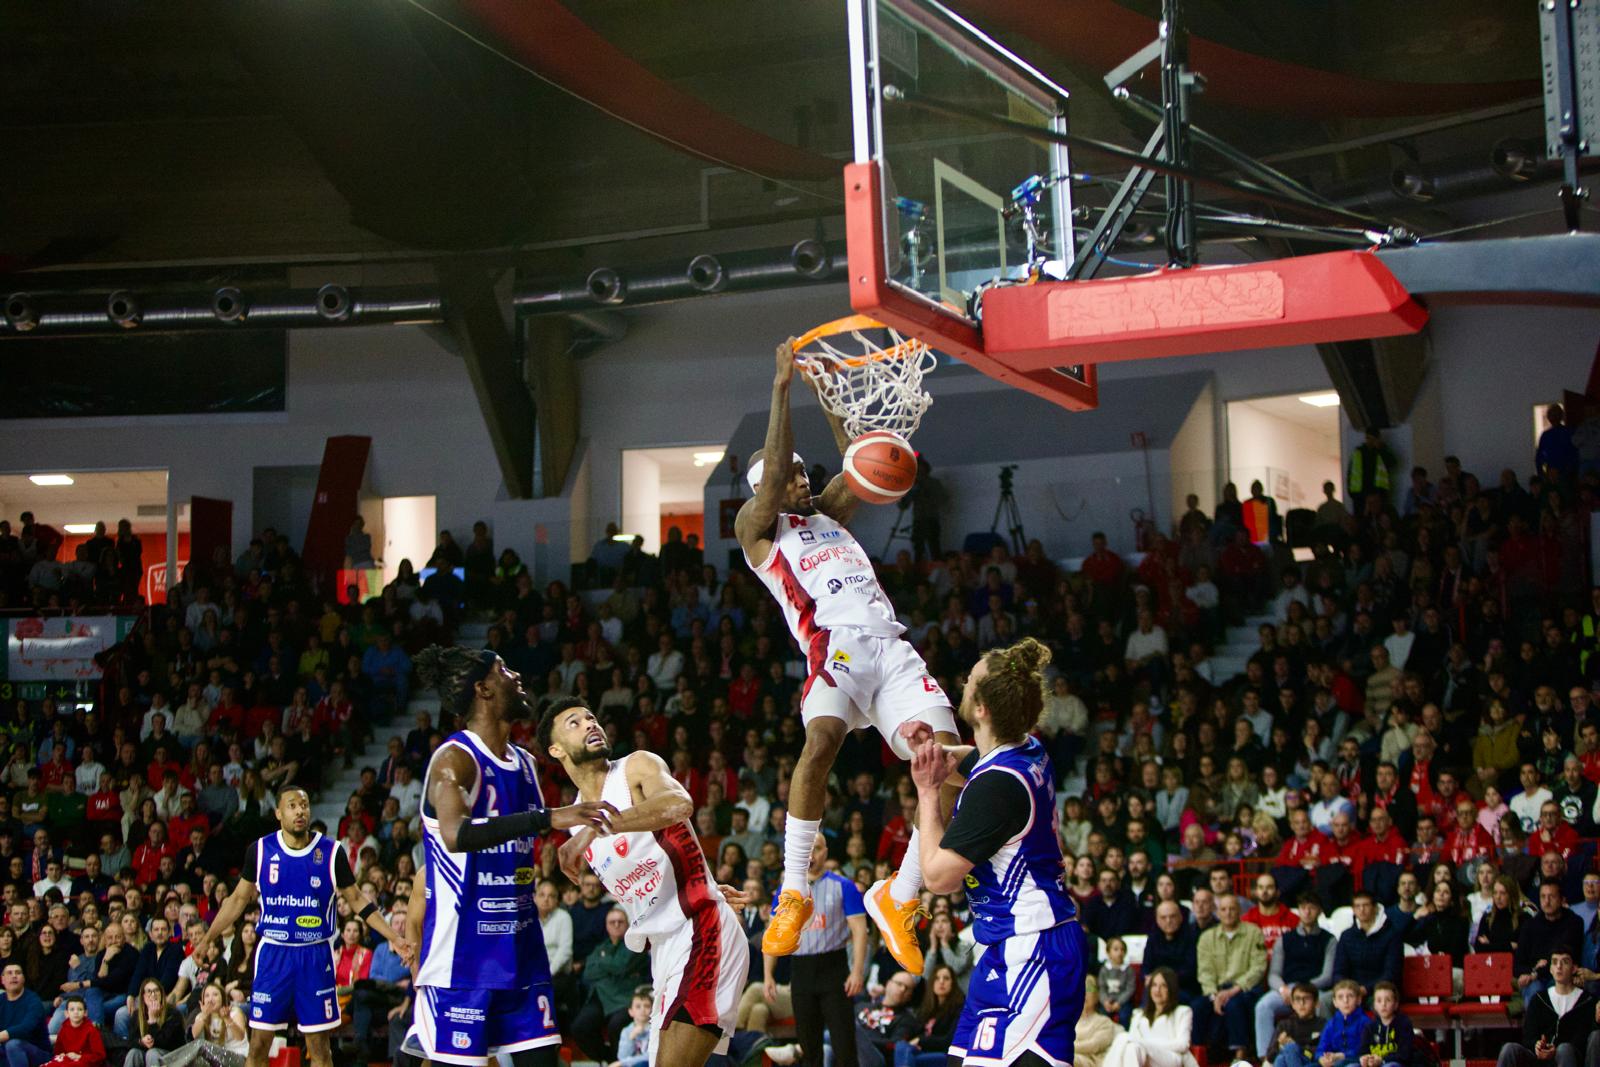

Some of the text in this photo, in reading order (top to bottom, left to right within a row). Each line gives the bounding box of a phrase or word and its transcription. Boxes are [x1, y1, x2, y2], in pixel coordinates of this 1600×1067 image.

[486, 784, 499, 817] 2
[269, 863, 280, 885] 5
[324, 997, 333, 1020] 5
[537, 995, 555, 1029] 2
[972, 1017, 998, 1050] 15
